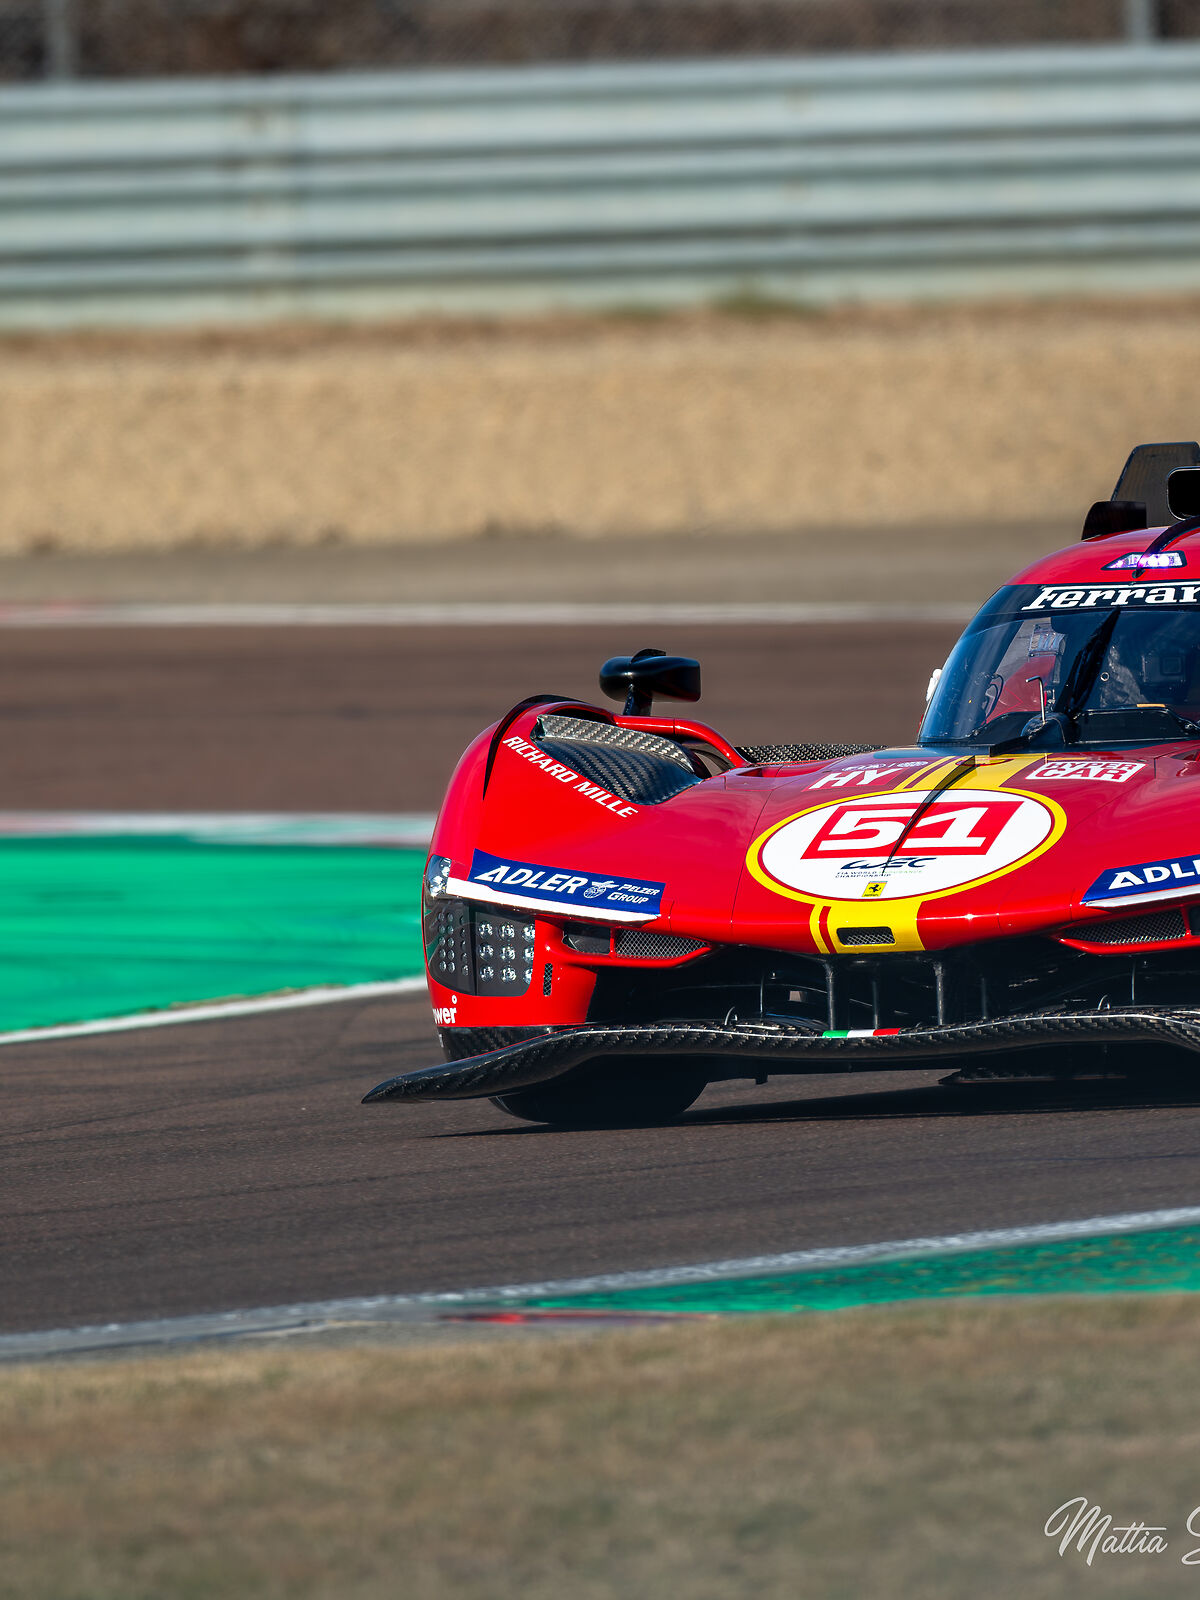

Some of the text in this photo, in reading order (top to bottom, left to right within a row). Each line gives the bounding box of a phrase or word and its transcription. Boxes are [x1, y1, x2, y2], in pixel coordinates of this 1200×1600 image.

[502, 735, 639, 818] RICHARD MILLE
[1035, 768, 1128, 780] CAR
[1045, 762, 1138, 770] HYPER
[808, 768, 904, 790] HY
[816, 806, 990, 852] 51
[473, 865, 661, 896] ADLER PELZER
[607, 892, 649, 904] GROUP
